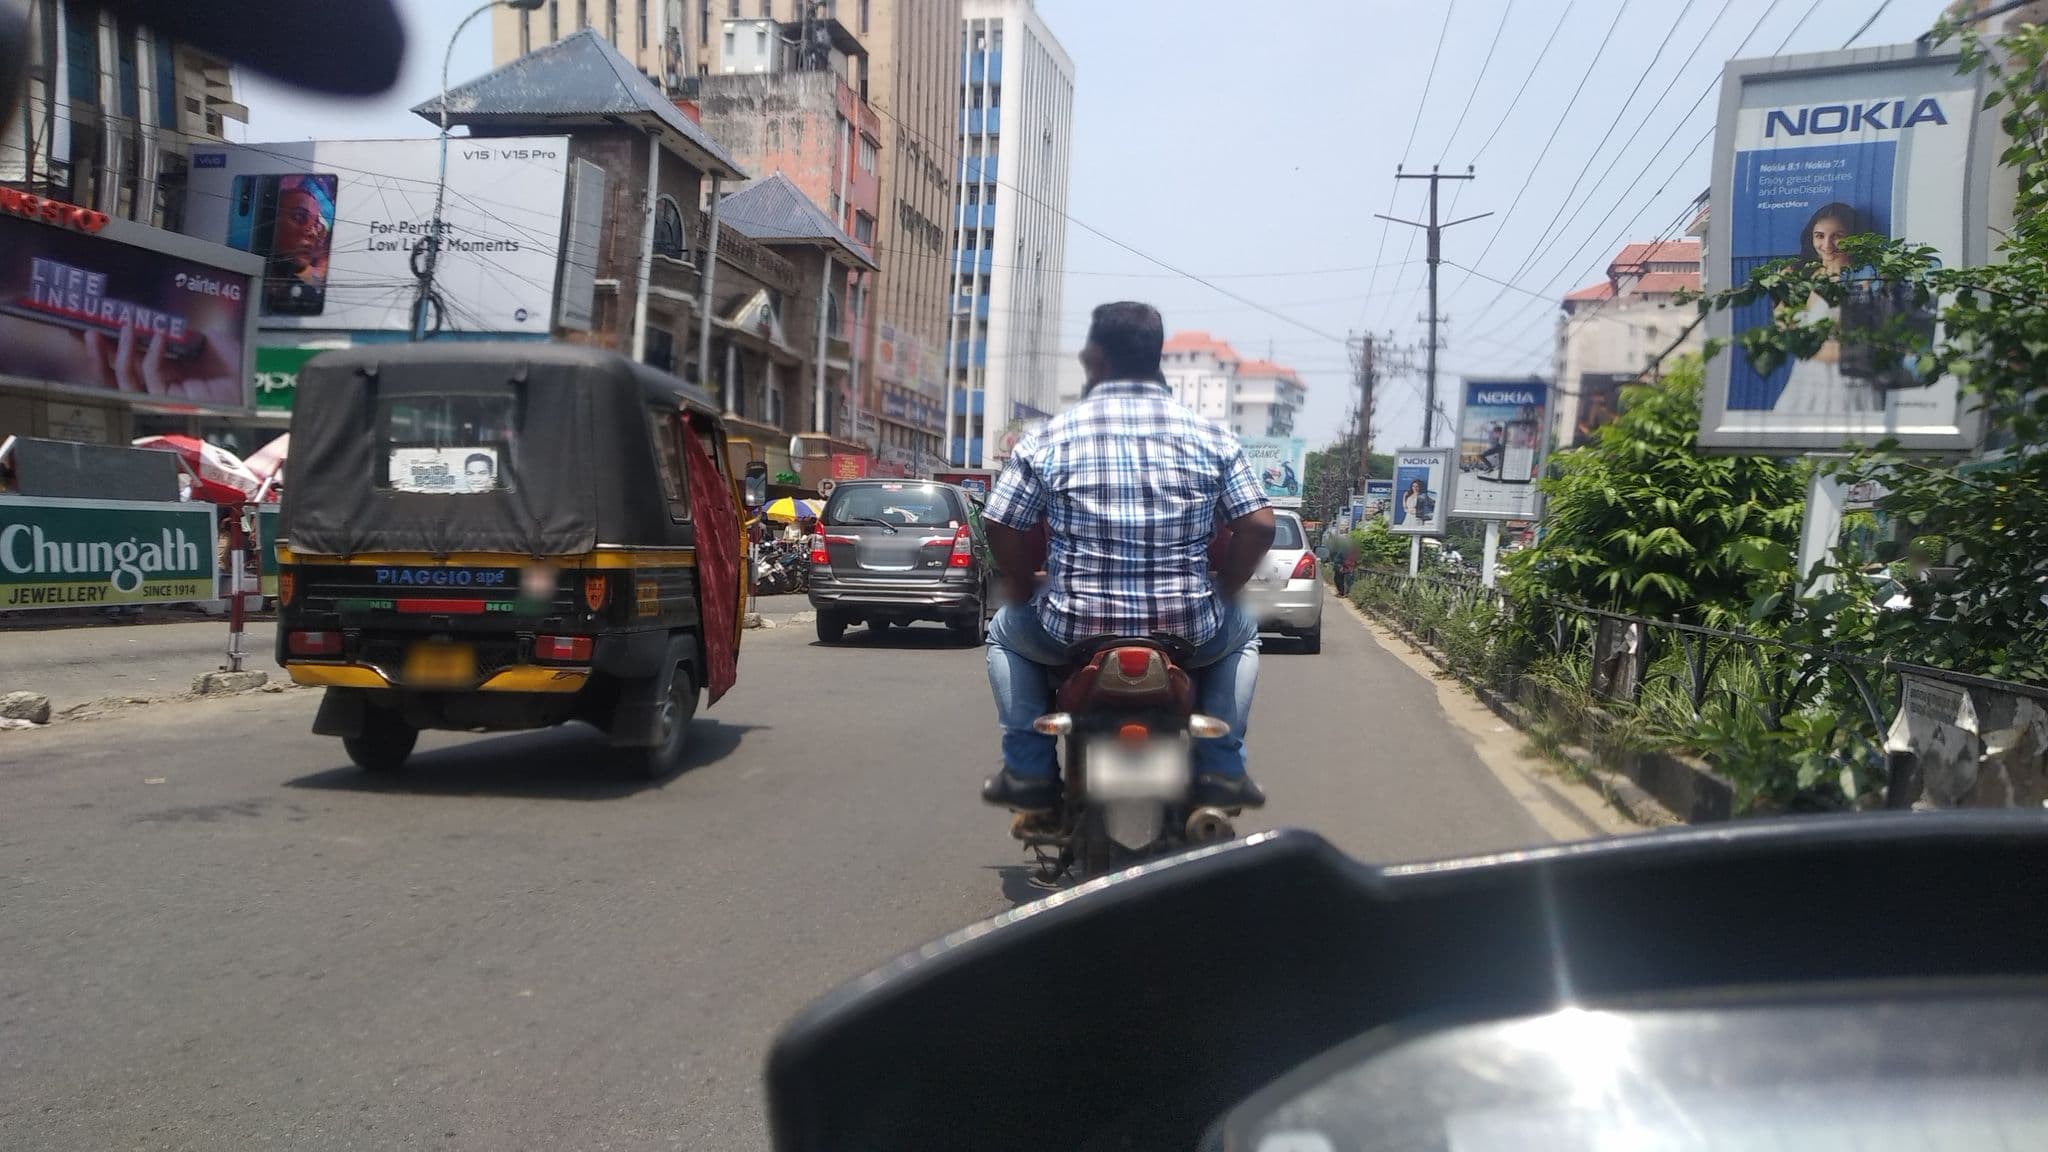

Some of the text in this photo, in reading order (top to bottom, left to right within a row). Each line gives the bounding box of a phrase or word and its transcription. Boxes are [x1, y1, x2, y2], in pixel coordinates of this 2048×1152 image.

[1765, 98, 1948, 138] NOKIA
[463, 149, 556, 160] V15 V15 Pro
[1759, 175, 1784, 187] Enjoy
[1786, 175, 1811, 186] great
[1758, 187, 1776, 197] and
[370, 220, 453, 234] For Perfct
[368, 238, 398, 251] Low
[448, 238, 519, 252] Moments
[31, 258, 100, 295] LIFE
[186, 275, 241, 300] airtel 4G
[33, 284, 185, 337] INSURANCE
[1477, 391, 1535, 404] NOKIA
[0, 523, 199, 593] Chungath
[375, 569, 471, 586] PIAGGIO
[8, 583, 196, 605] JEWELLERY SINCE 1914
